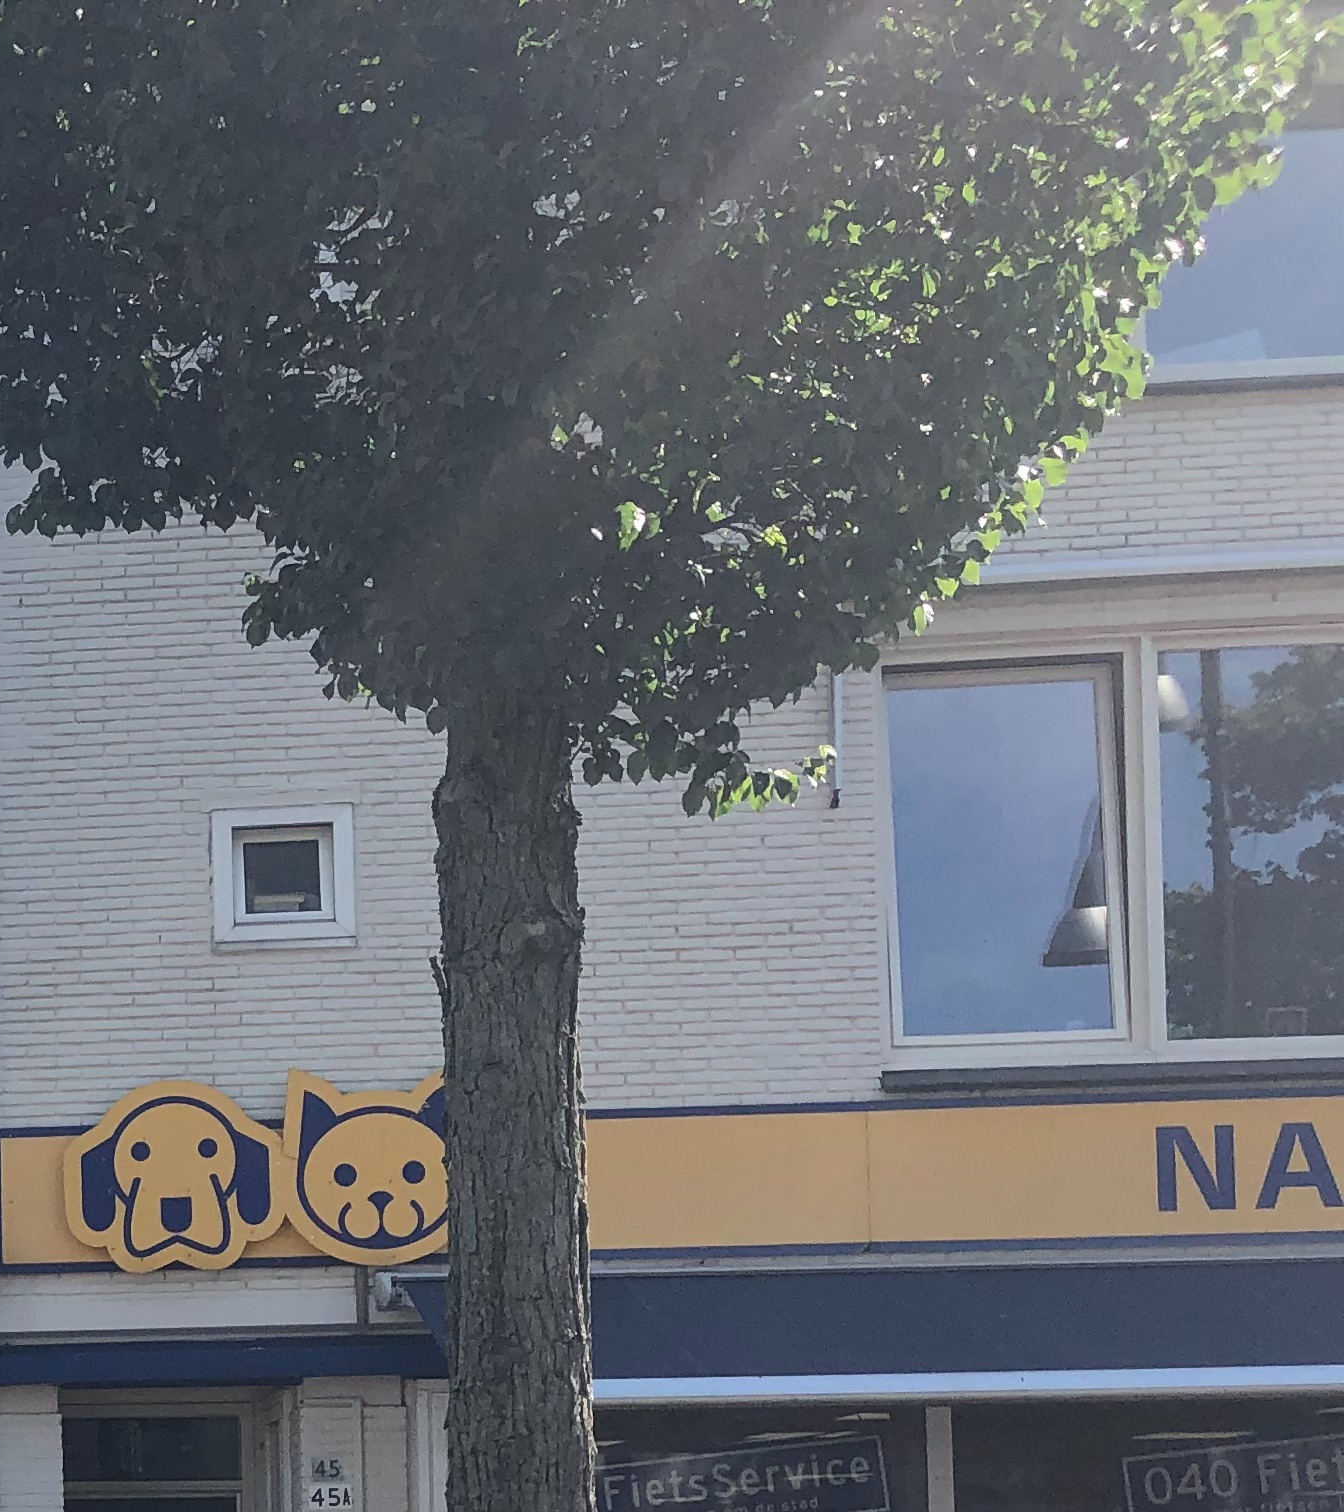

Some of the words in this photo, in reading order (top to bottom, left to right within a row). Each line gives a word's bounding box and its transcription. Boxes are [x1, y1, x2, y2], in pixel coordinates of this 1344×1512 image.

[1155, 1122, 1344, 1212] NA
[314, 1460, 340, 1478] 45
[603, 1453, 871, 1511] FietsService
[1144, 1458, 1239, 1505] 040
[311, 1487, 351, 1507] 45A
